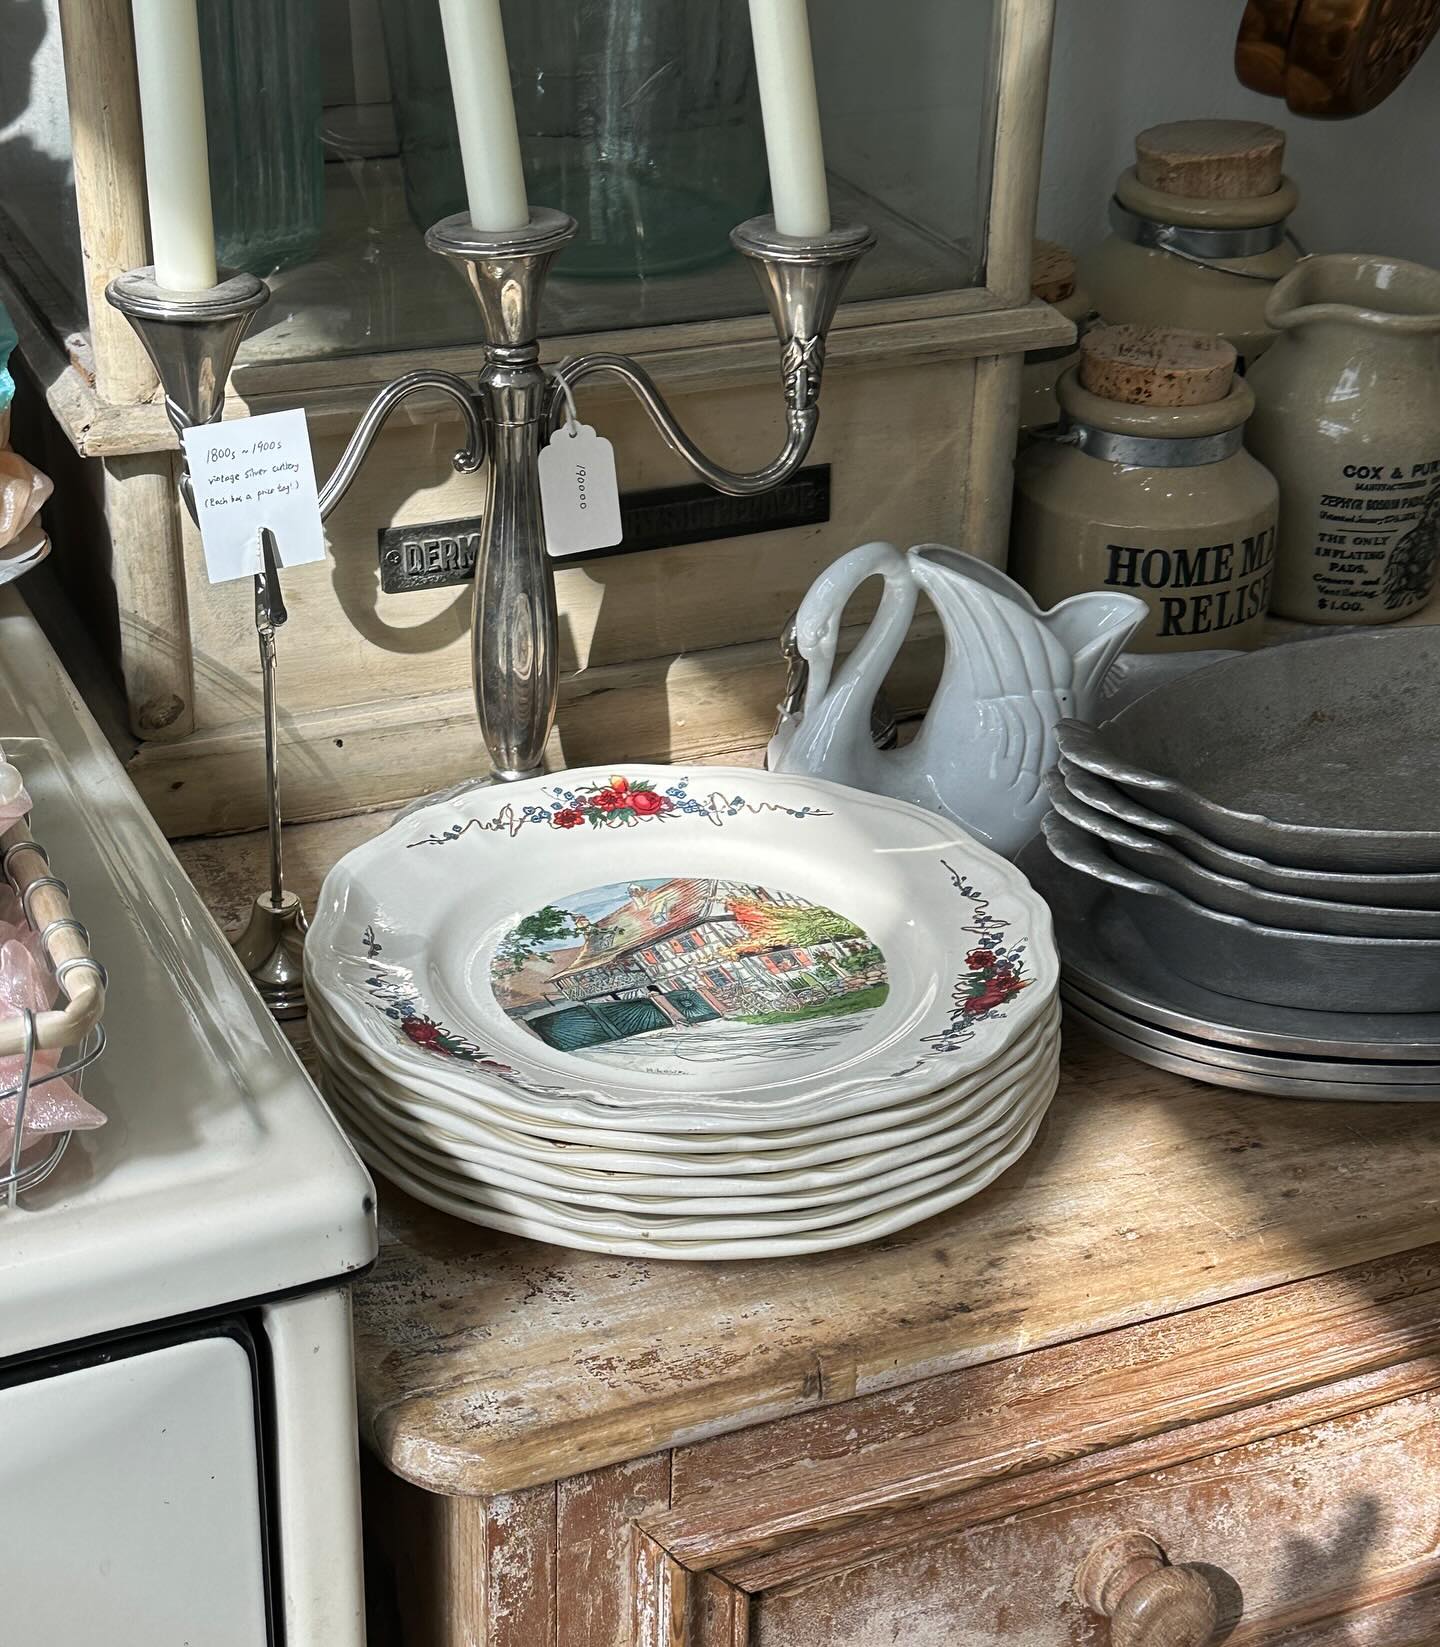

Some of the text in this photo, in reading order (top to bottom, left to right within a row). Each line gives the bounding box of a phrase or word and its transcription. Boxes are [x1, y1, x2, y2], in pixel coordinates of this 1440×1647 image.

[206, 447, 236, 464] 1800s
[252, 440, 282, 455] 1900s
[208, 473, 240, 486] vintage
[1343, 464, 1385, 481] COX
[1390, 467, 1404, 480] &
[576, 464, 587, 510] 190000
[1318, 533, 1391, 547] THE ONLY
[401, 533, 481, 576] DERM
[1314, 547, 1386, 561] INFLATING
[1104, 544, 1234, 589] HOME
